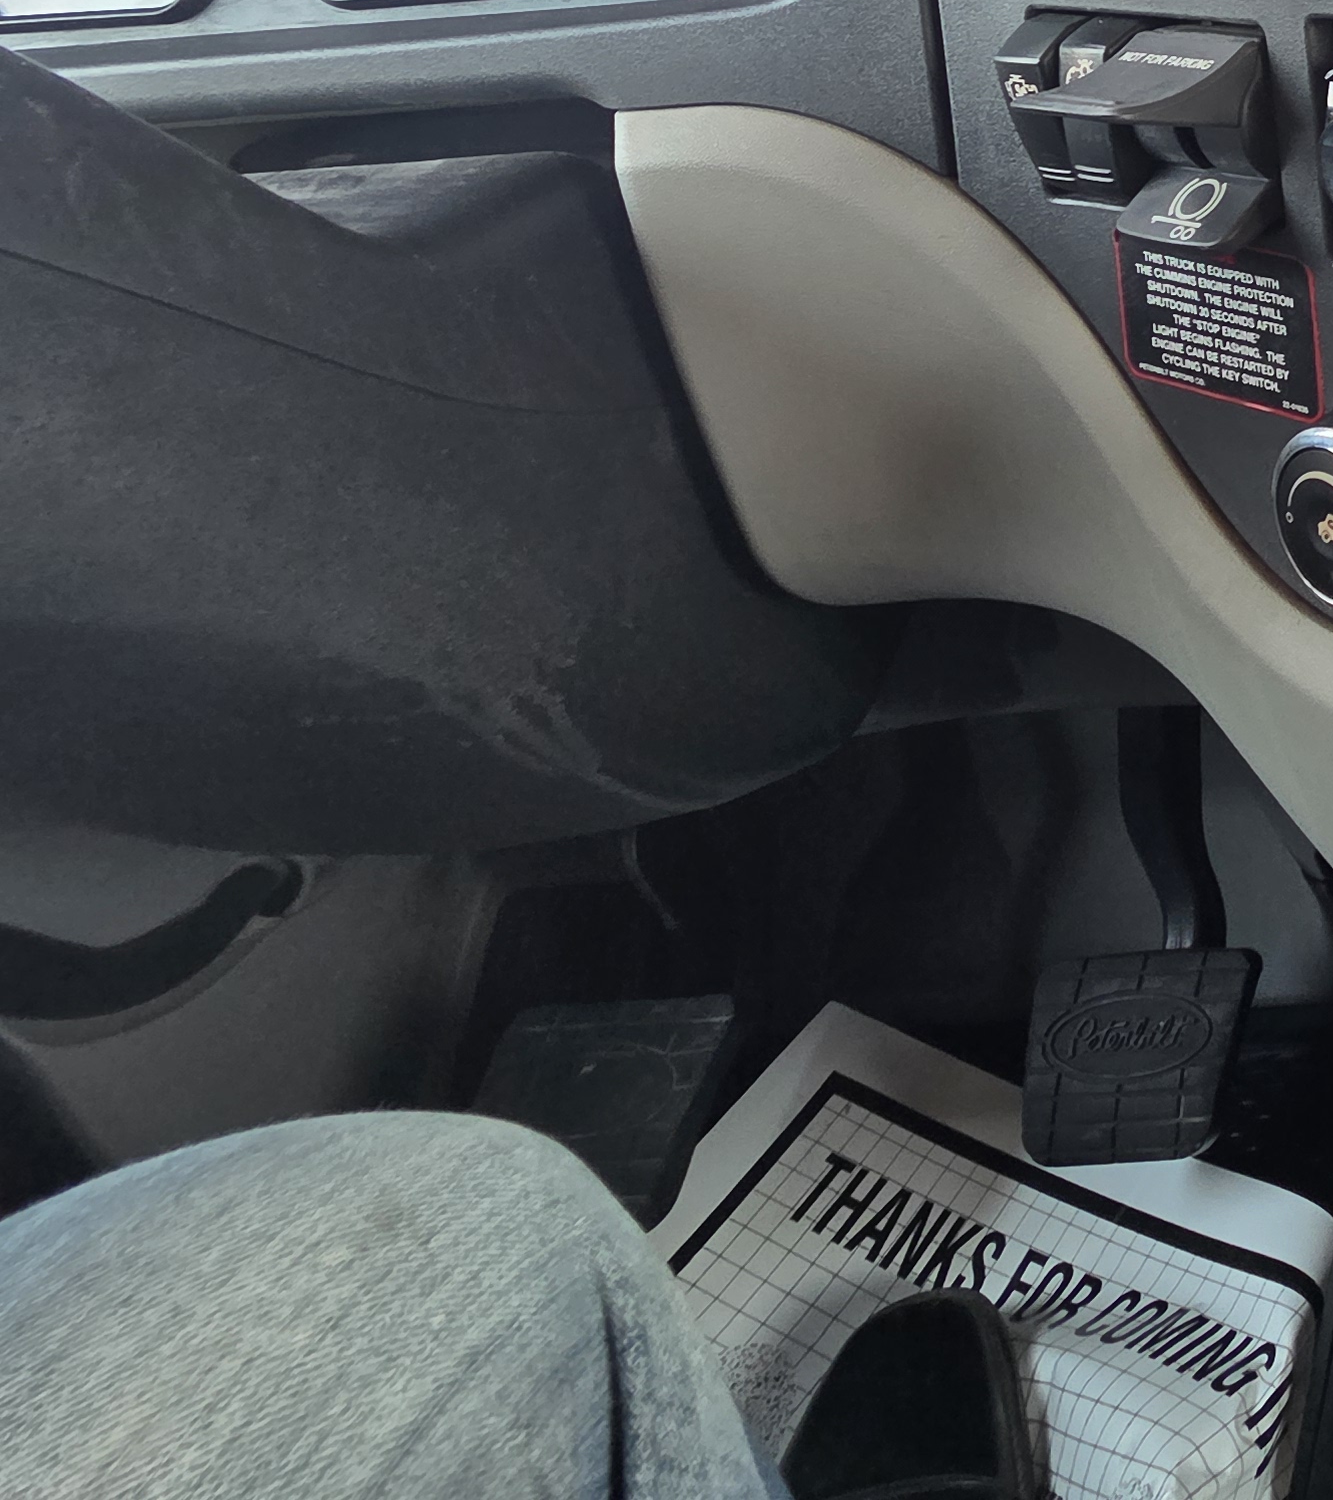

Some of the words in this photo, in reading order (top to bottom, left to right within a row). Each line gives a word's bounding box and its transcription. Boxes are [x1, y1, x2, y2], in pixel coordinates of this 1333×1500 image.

[1119, 52, 1147, 62] NOT
[1141, 53, 1168, 64] FOR
[1162, 55, 1215, 70] PARKING
[1135, 263, 1153, 276] THE
[1154, 268, 1197, 286] CUMMINS
[1198, 277, 1232, 294] ENGINE
[1233, 285, 1294, 308] PROTECTION
[1143, 251, 1164, 264] THIS
[1164, 255, 1195, 271] TRUCK
[1196, 263, 1206, 274] IS
[1207, 264, 1254, 284] EQUIPPED
[1254, 275, 1280, 290] WITH
[1146, 294, 1198, 314] SHUTDOWN
[1210, 309, 1255, 328] SECONDS
[1256, 320, 1287, 336] AFTER
[1173, 314, 1191, 327] THE
[1204, 293, 1222, 306] THE
[1224, 297, 1259, 315] ENGINE
[1260, 306, 1283, 320] WILL
[1151, 337, 1184, 353] ENGINE
[1186, 345, 1205, 359] CAN
[1206, 350, 1219, 363] BE
[1220, 354, 1275, 376] RESTARTED
[1276, 368, 1289, 380] BY
[1153, 323, 1178, 338] LIGHT
[1180, 330, 1213, 347] BEGINS
[1266, 351, 1286, 366] THE
[1162, 353, 1201, 372] CYCLING
[1202, 363, 1220, 378] THE
[1222, 369, 1240, 382] KEY
[789, 1151, 1007, 1292] THANKS
[993, 1248, 1104, 1329] FOR
[1074, 1289, 1277, 1397] COMING
